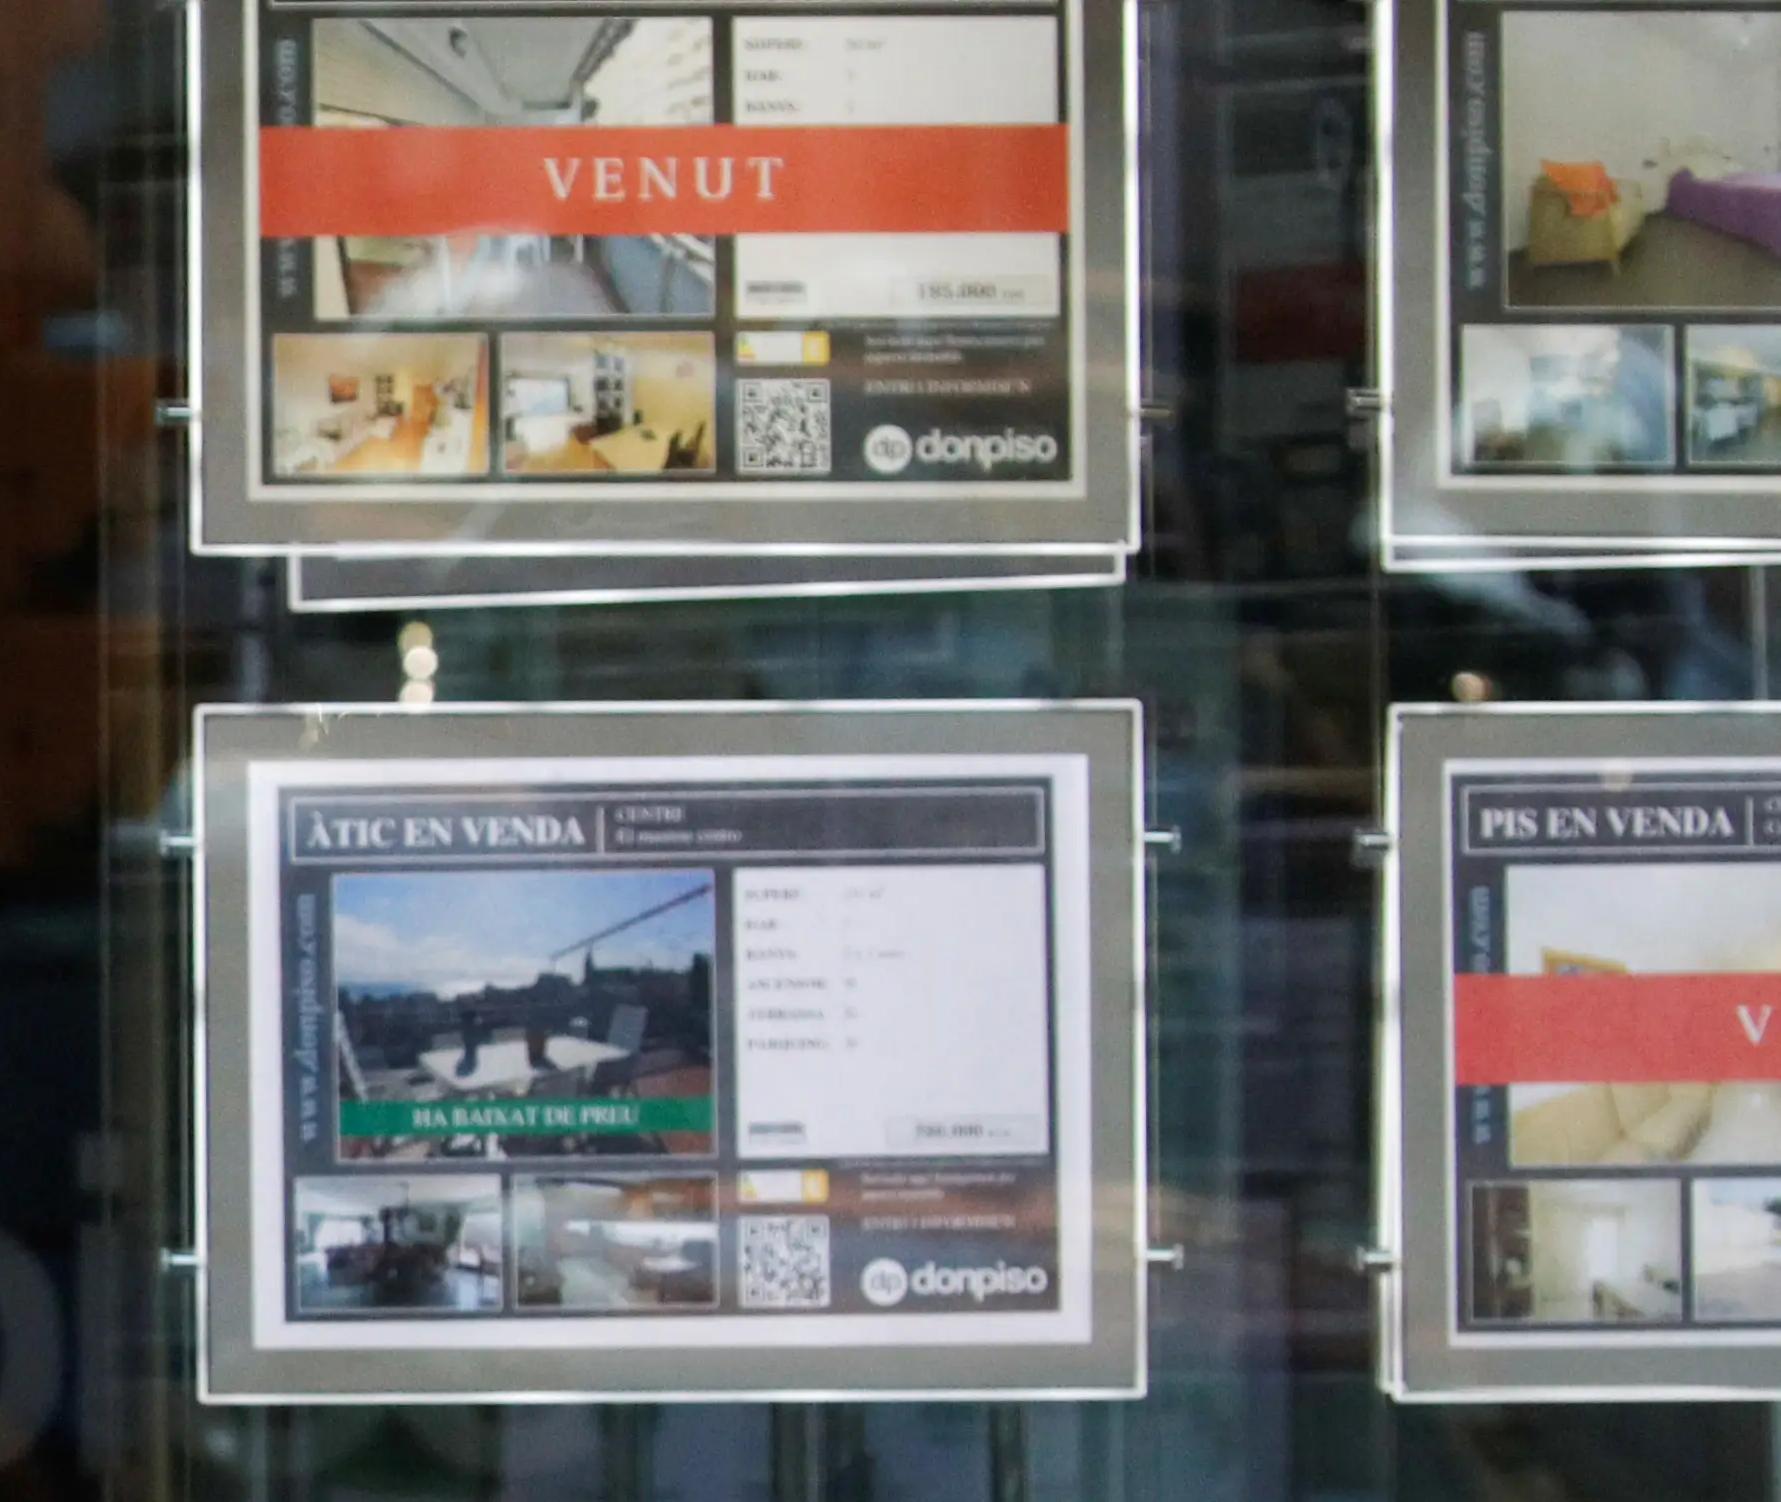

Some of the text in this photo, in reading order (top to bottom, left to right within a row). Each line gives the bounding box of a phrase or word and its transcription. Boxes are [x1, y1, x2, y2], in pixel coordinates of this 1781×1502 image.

[543, 156, 783, 201] VENUT
[914, 428, 1058, 472] donpiso
[310, 810, 584, 848] ÀTIC EN VENDA
[1481, 808, 1538, 839] PIS
[1547, 807, 1596, 838] EN
[1606, 806, 1734, 838] VENDA
[412, 1105, 448, 1129] HA
[452, 1105, 539, 1129] BAIXAT
[906, 1261, 1048, 1302] donpiso
